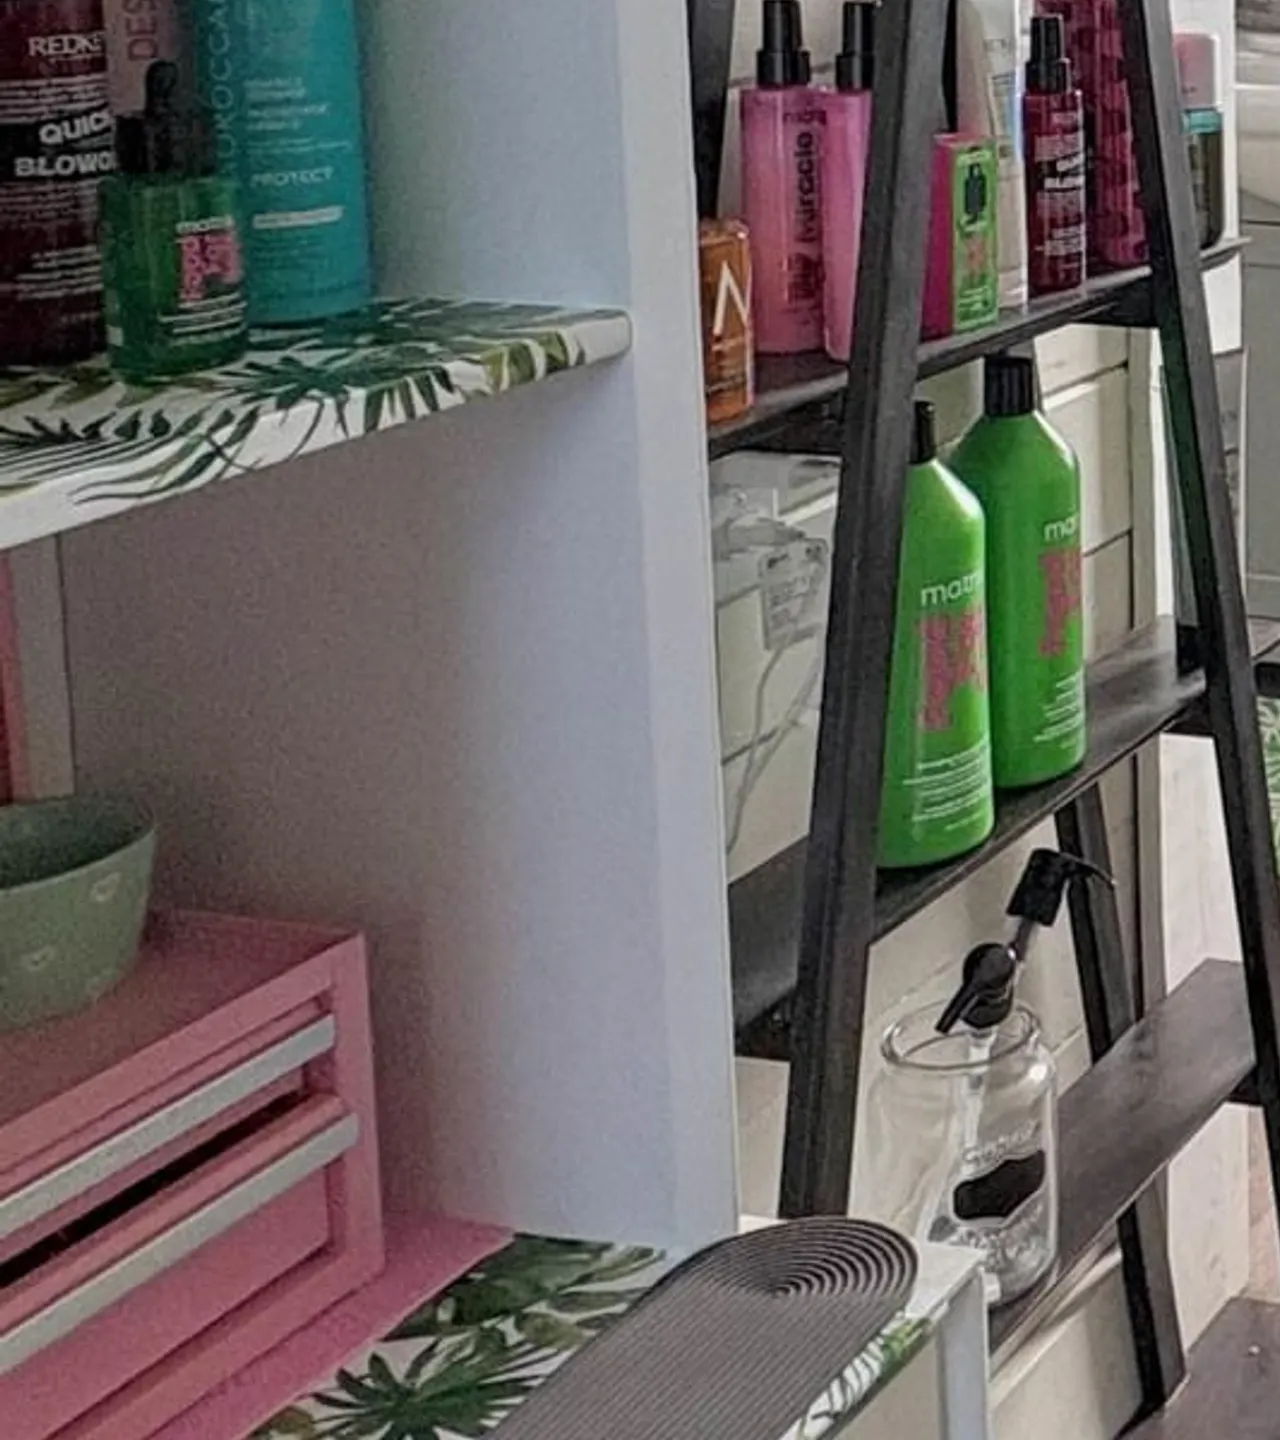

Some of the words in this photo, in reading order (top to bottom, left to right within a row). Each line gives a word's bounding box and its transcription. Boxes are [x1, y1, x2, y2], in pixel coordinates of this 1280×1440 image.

[28, 30, 104, 56] REDKE
[39, 109, 115, 145] QUIC
[14, 151, 116, 176] BLOWO
